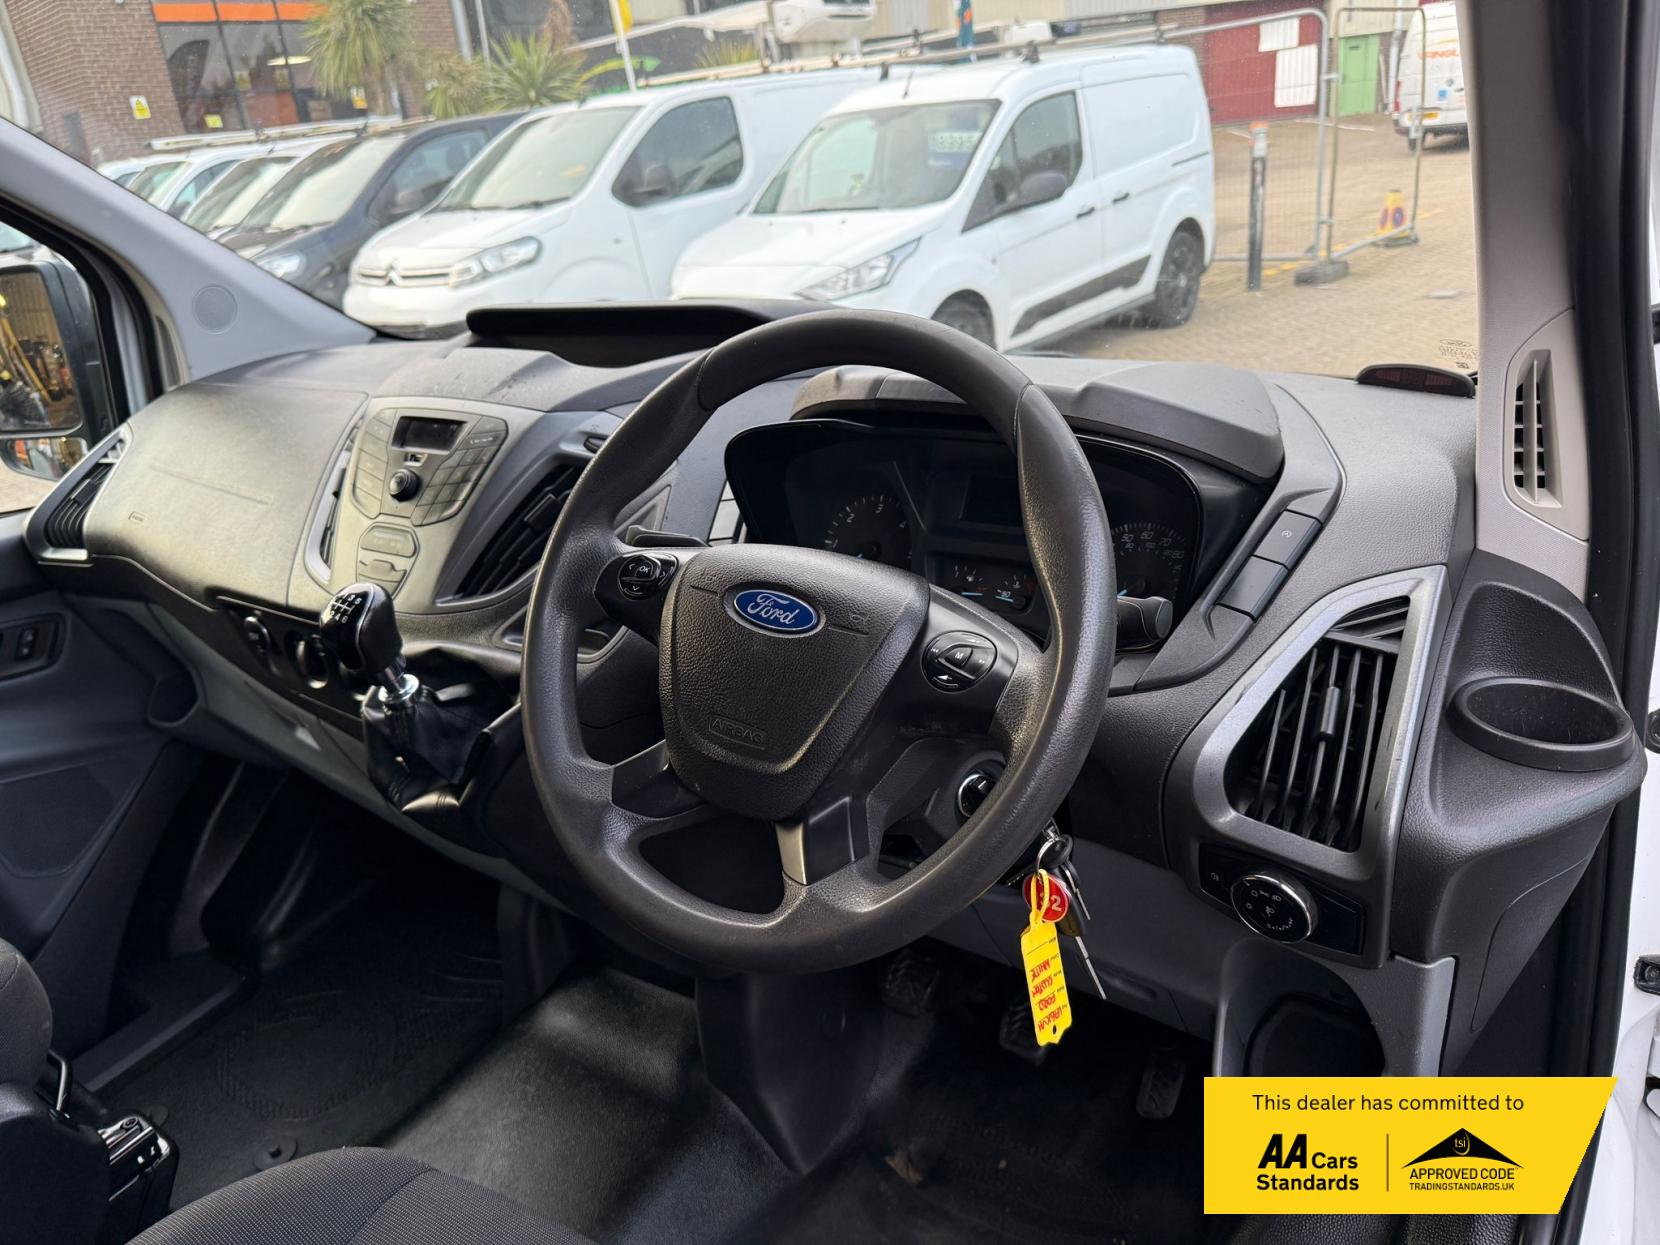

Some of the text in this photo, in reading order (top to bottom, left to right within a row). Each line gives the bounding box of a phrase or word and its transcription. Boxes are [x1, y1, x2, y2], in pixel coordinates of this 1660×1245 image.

[846, 513, 856, 523] 2
[639, 565, 651, 573] OK
[747, 593, 801, 624] Ford
[711, 718, 764, 744] AIRBAG
